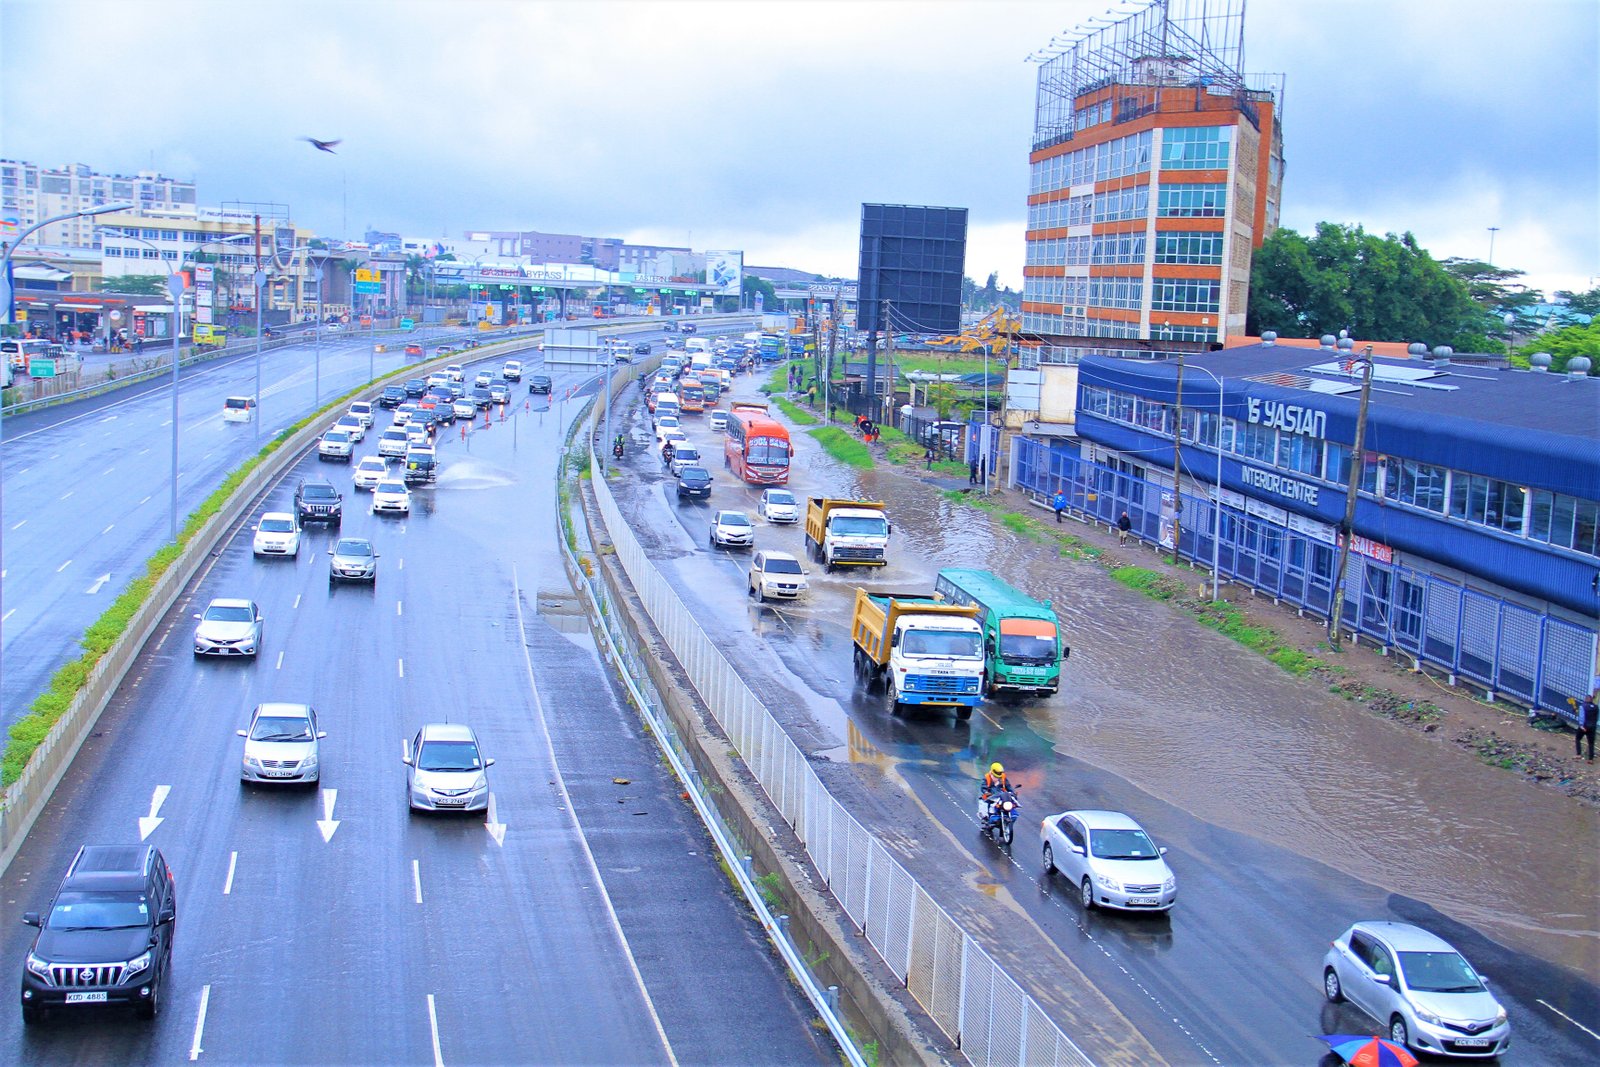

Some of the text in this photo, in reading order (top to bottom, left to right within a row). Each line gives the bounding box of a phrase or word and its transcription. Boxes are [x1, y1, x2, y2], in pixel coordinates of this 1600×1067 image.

[526, 269, 562, 280] BYPASS
[1263, 400, 1327, 440] YASIAN
[1242, 465, 1280, 496] INTERIOR
[1280, 478, 1319, 506] CENTRE
[1354, 536, 1375, 559] SALE
